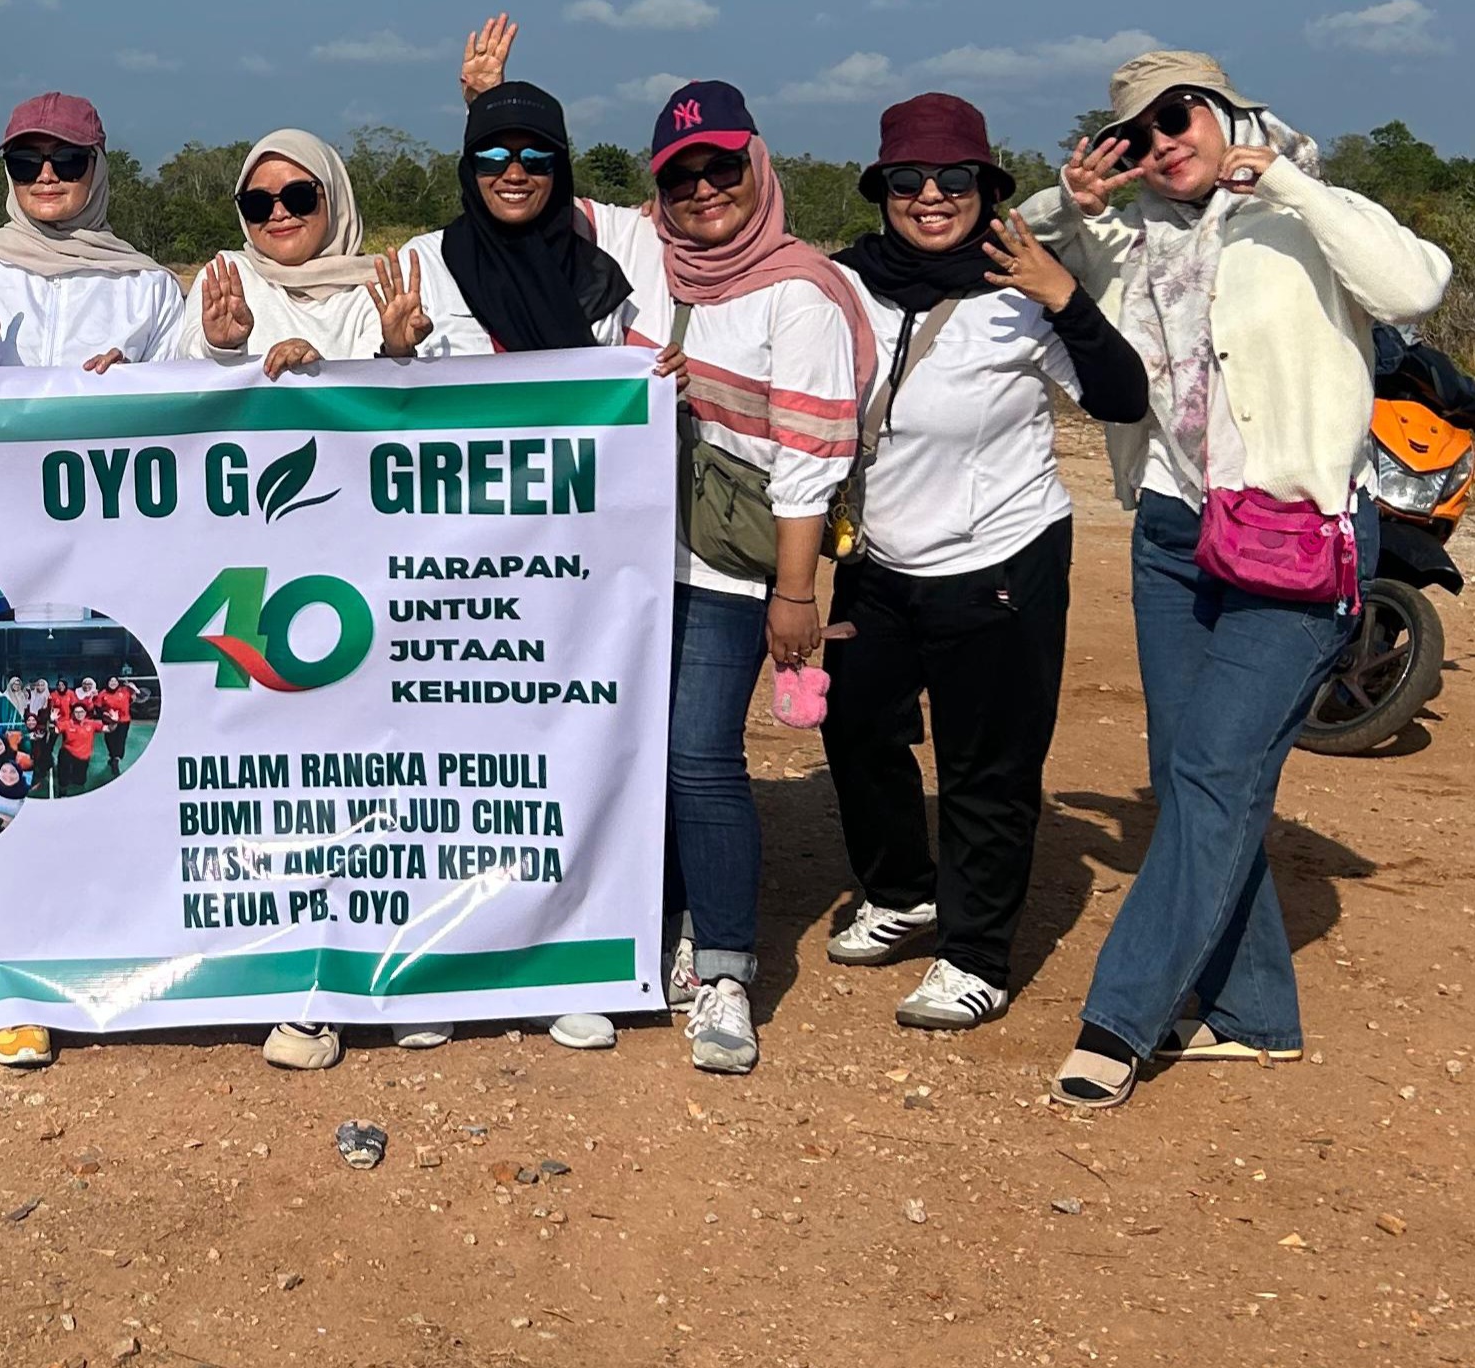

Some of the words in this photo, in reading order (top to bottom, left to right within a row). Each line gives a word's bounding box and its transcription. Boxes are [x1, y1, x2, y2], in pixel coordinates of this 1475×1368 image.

[42, 446, 178, 521] OYO
[369, 438, 596, 516] GREEN
[388, 554, 590, 580] HARAPAN,
[388, 597, 522, 623] UNTUK
[160, 566, 374, 692] 40
[389, 639, 545, 662] JUTAAN
[391, 680, 618, 704] KEHIDUPAN
[177, 754, 290, 790] DALAM
[301, 752, 428, 787] RANGKA
[438, 753, 547, 789] PEDULI
[179, 801, 263, 836] BUMI
[273, 798, 337, 835] DAN
[347, 797, 461, 834] WUJUD
[472, 799, 565, 837] CINTA
[283, 843, 427, 880] ANGGOTA
[183, 890, 280, 929] KETUA
[288, 888, 339, 926] PB.
[349, 889, 410, 926] OYO
